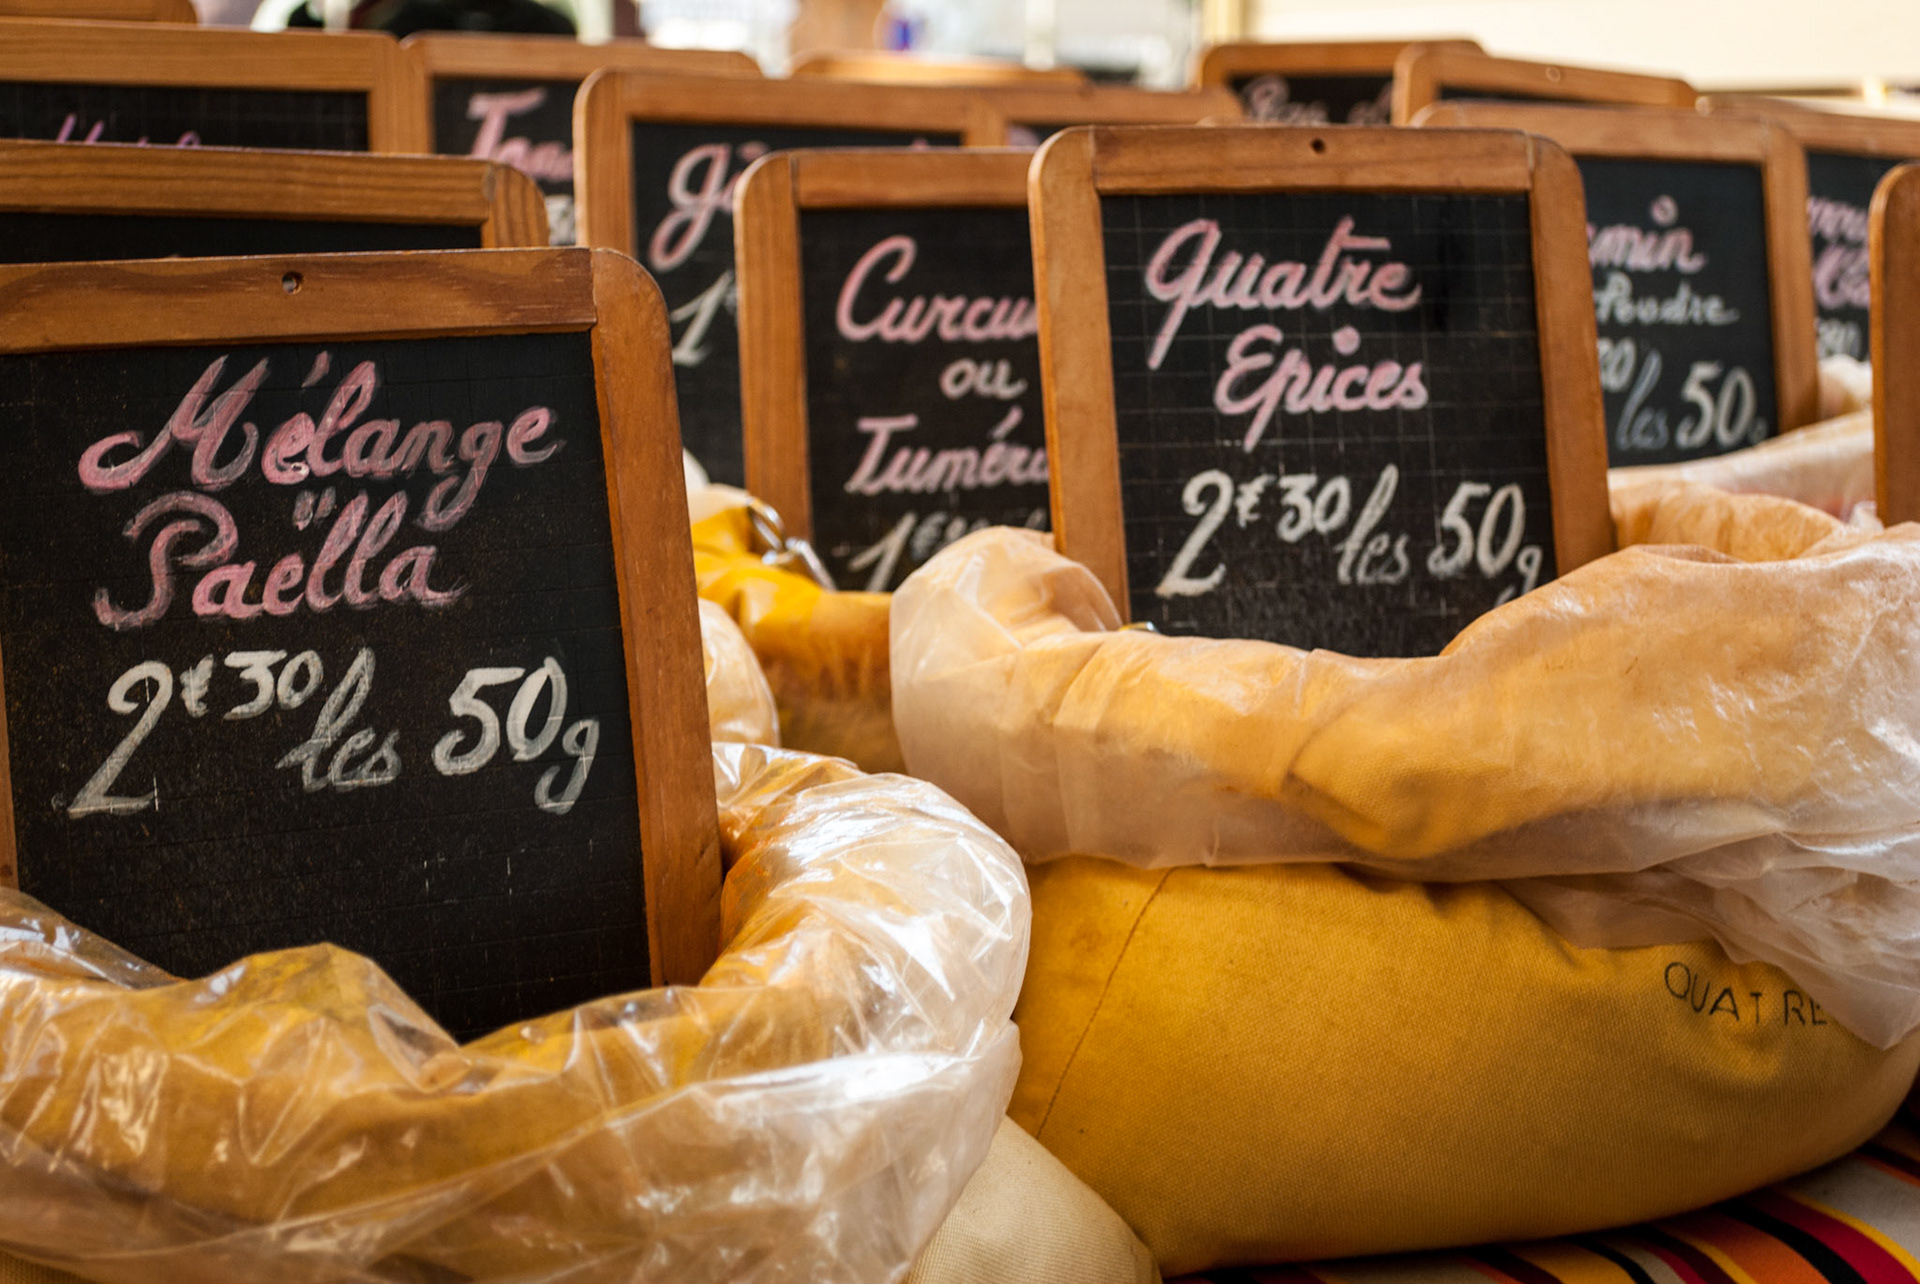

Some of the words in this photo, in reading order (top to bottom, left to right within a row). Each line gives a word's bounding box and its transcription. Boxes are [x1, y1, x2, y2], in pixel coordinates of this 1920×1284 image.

[836, 234, 1038, 342] Curcu
[1145, 215, 1422, 370] Quatre
[1586, 195, 1708, 274] min
[939, 358, 1028, 399] ou
[1214, 324, 1429, 453] Epices
[1617, 350, 1669, 449] les
[78, 351, 565, 531] Mélange
[94, 487, 469, 631] Paëlla
[1334, 463, 1410, 585] les
[275, 647, 401, 793] les
[431, 655, 600, 815] 50g
[1664, 961, 1828, 1027] QUATRE
